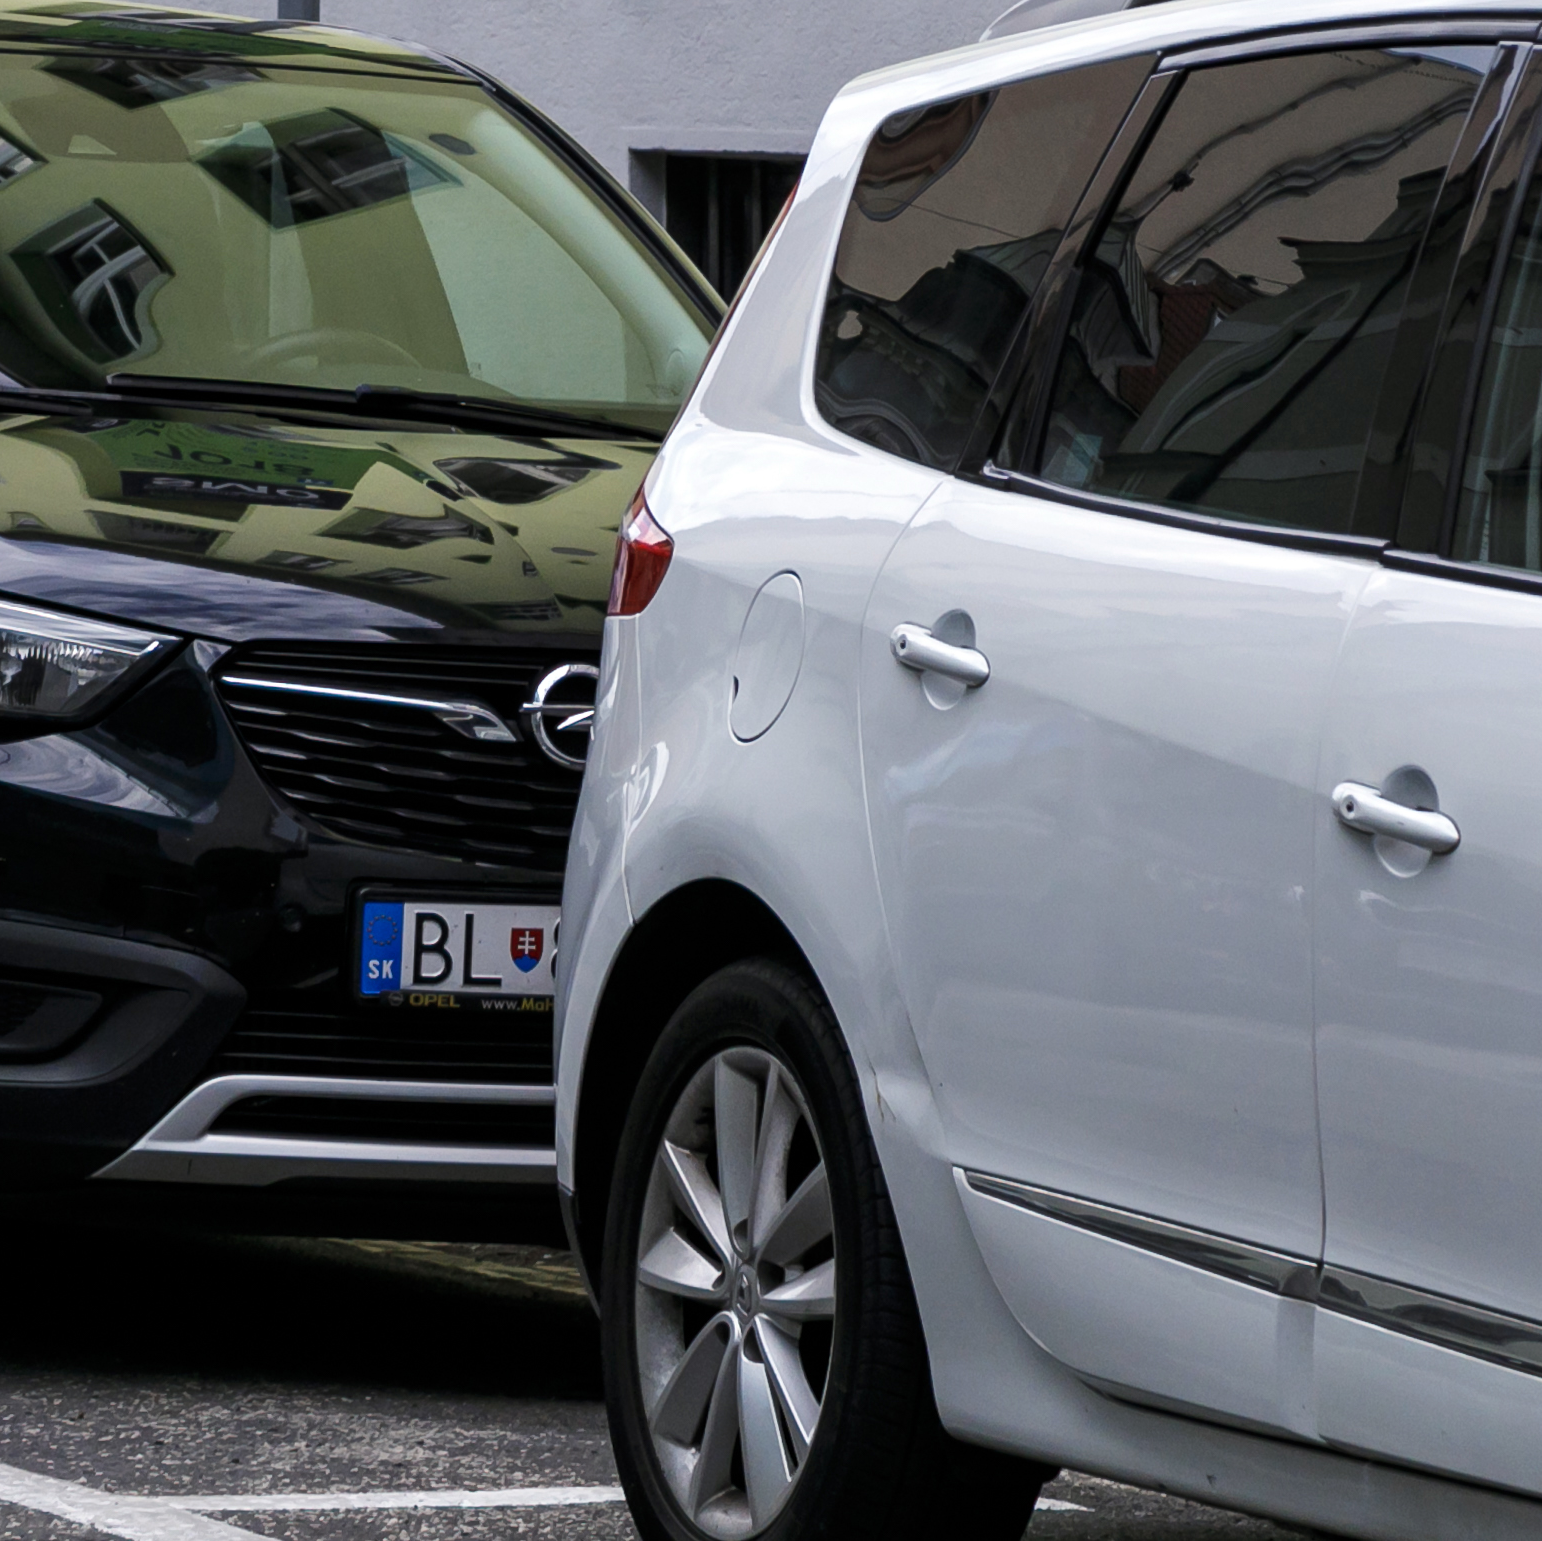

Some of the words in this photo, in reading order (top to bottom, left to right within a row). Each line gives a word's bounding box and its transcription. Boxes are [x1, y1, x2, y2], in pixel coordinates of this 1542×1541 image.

[411, 911, 503, 987] BL
[368, 959, 394, 980] SK
[409, 994, 461, 1008] OPEL
